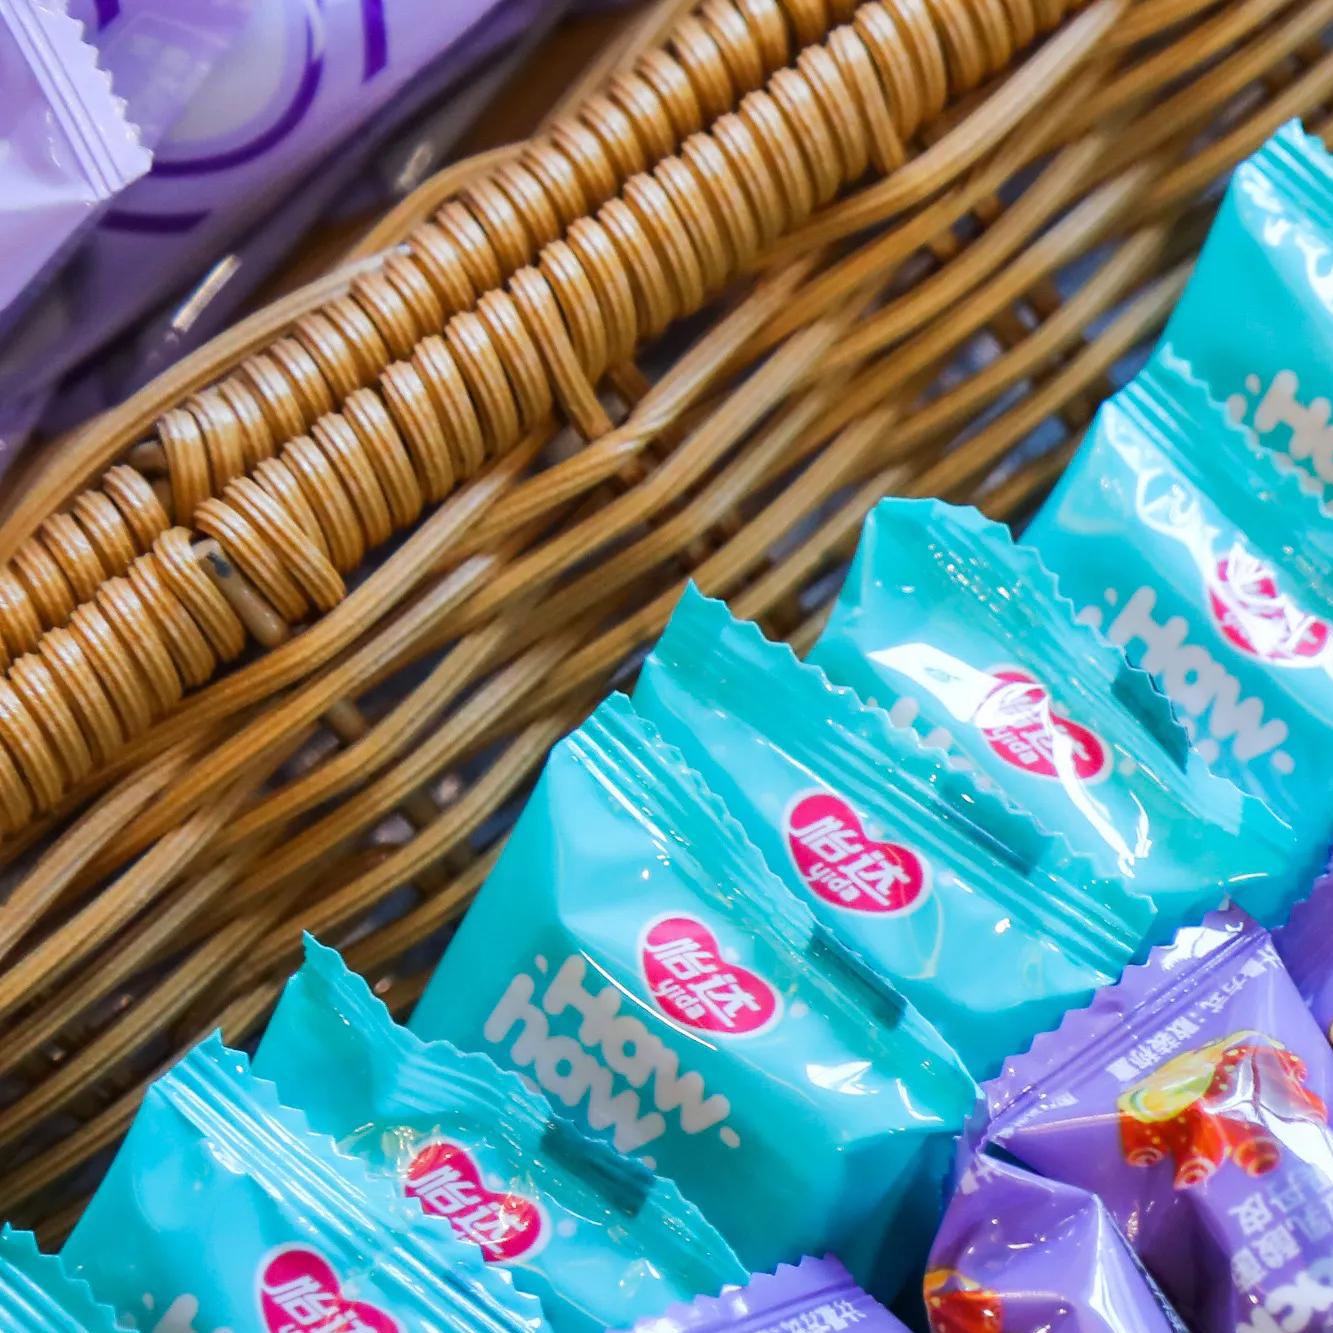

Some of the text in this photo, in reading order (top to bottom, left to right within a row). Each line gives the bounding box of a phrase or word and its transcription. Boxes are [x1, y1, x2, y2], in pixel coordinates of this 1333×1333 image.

[788, 815, 911, 906] 怡达
[806, 861, 859, 904] yida
[644, 937, 763, 1028] 怡达
[652, 979, 702, 1022] yida
